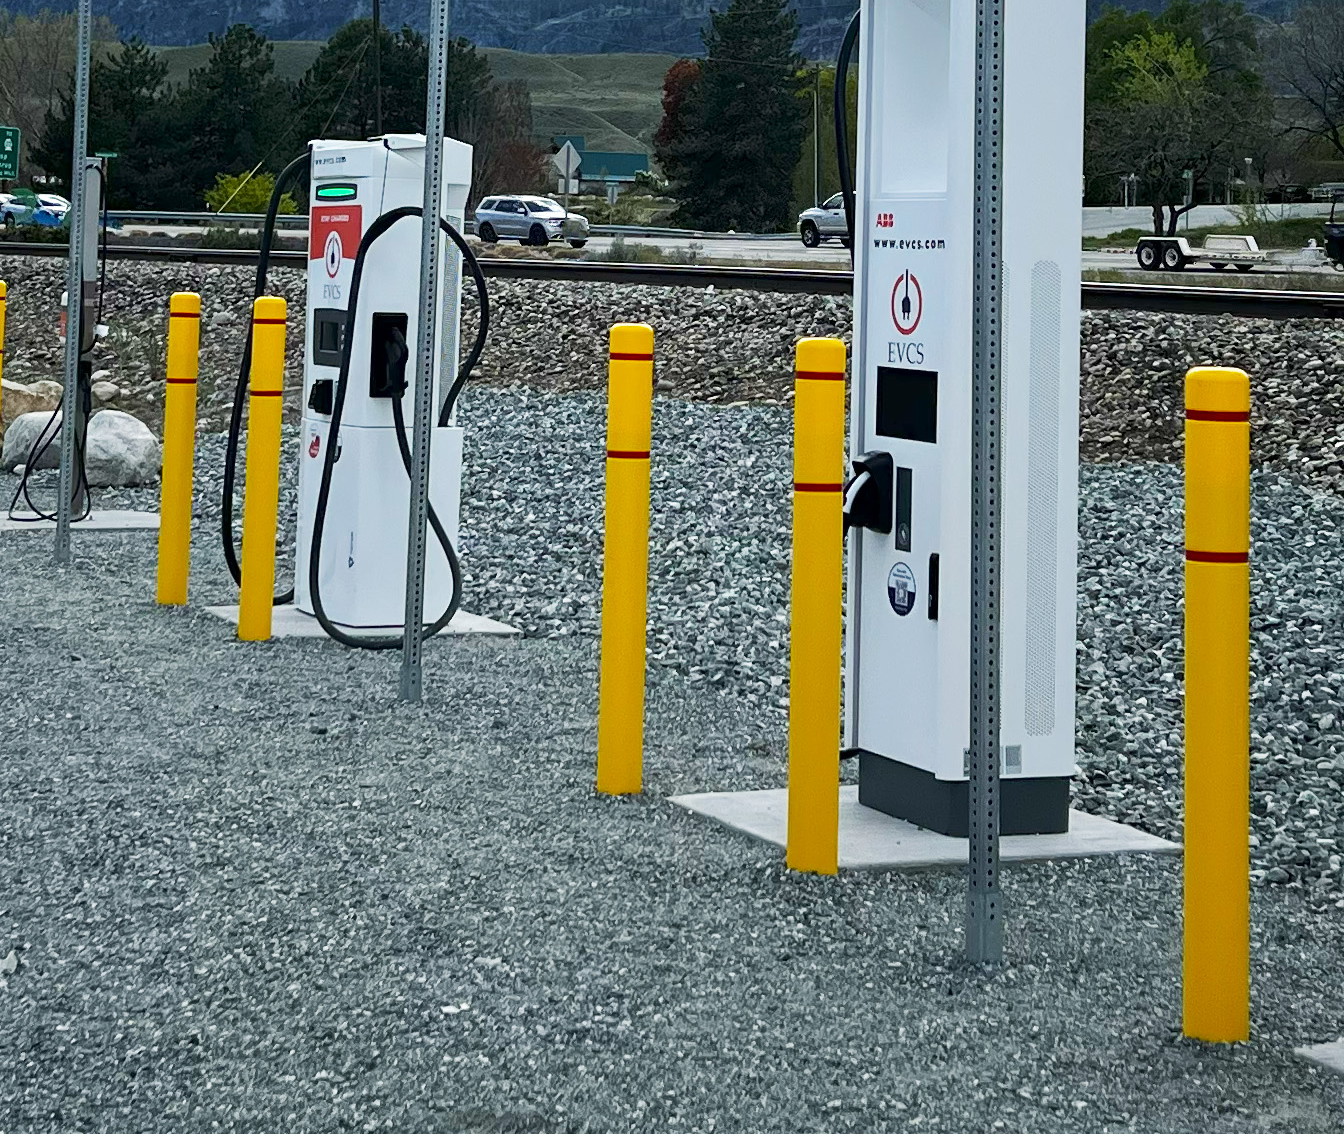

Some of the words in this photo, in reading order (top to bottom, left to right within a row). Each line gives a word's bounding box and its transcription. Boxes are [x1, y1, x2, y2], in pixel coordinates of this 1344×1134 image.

[876, 213, 894, 228] ABB
[873, 239, 946, 250] www.evcs.com
[323, 284, 341, 300] EVCS
[887, 341, 925, 365] EVCS
